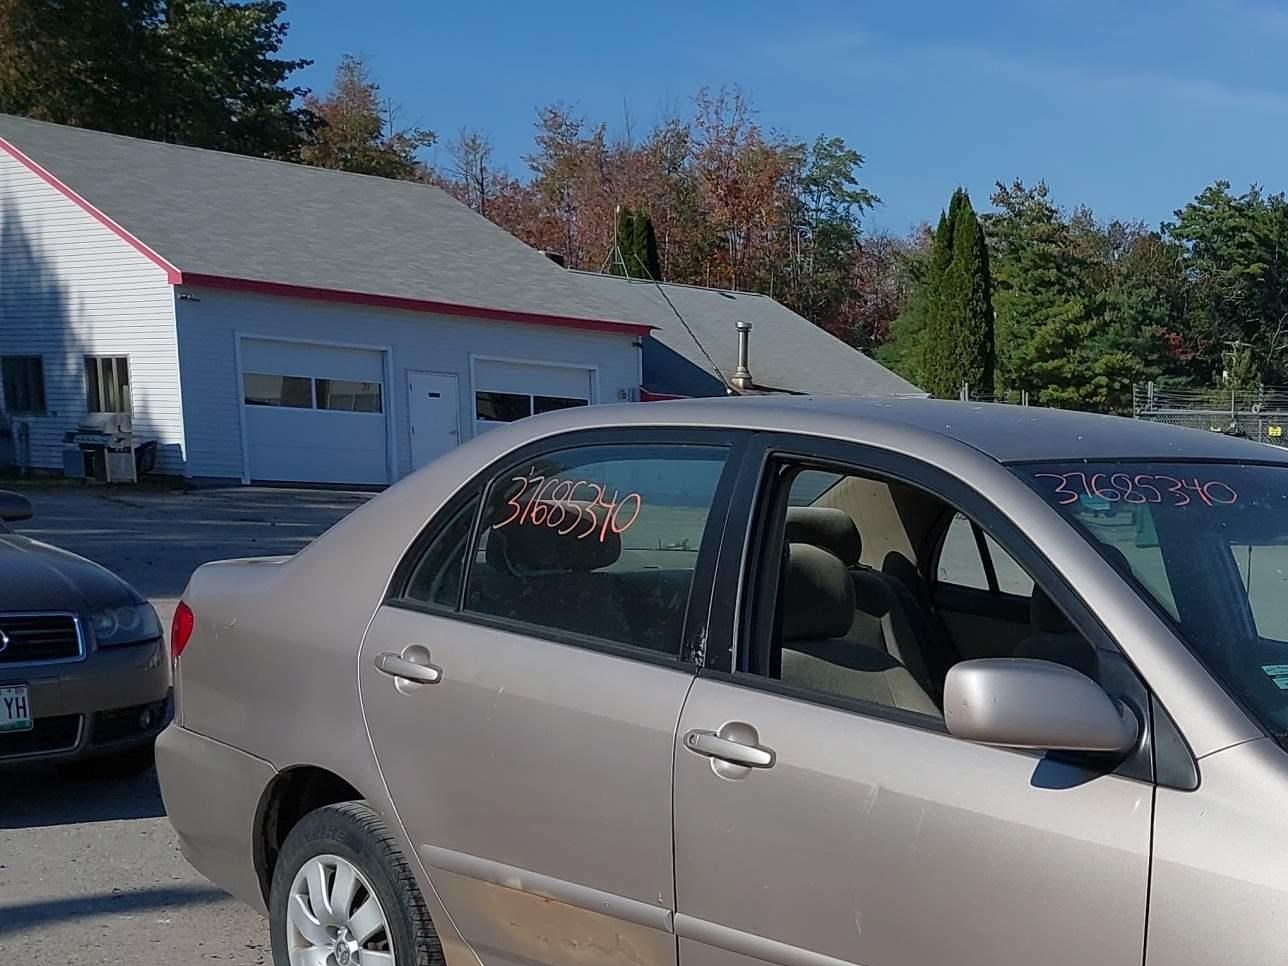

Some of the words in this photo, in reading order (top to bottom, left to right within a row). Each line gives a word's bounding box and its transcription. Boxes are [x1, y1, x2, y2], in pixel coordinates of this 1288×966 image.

[1034, 471, 1238, 507] 37685340
[493, 474, 641, 543] 37685340
[3, 696, 27, 720] YH
